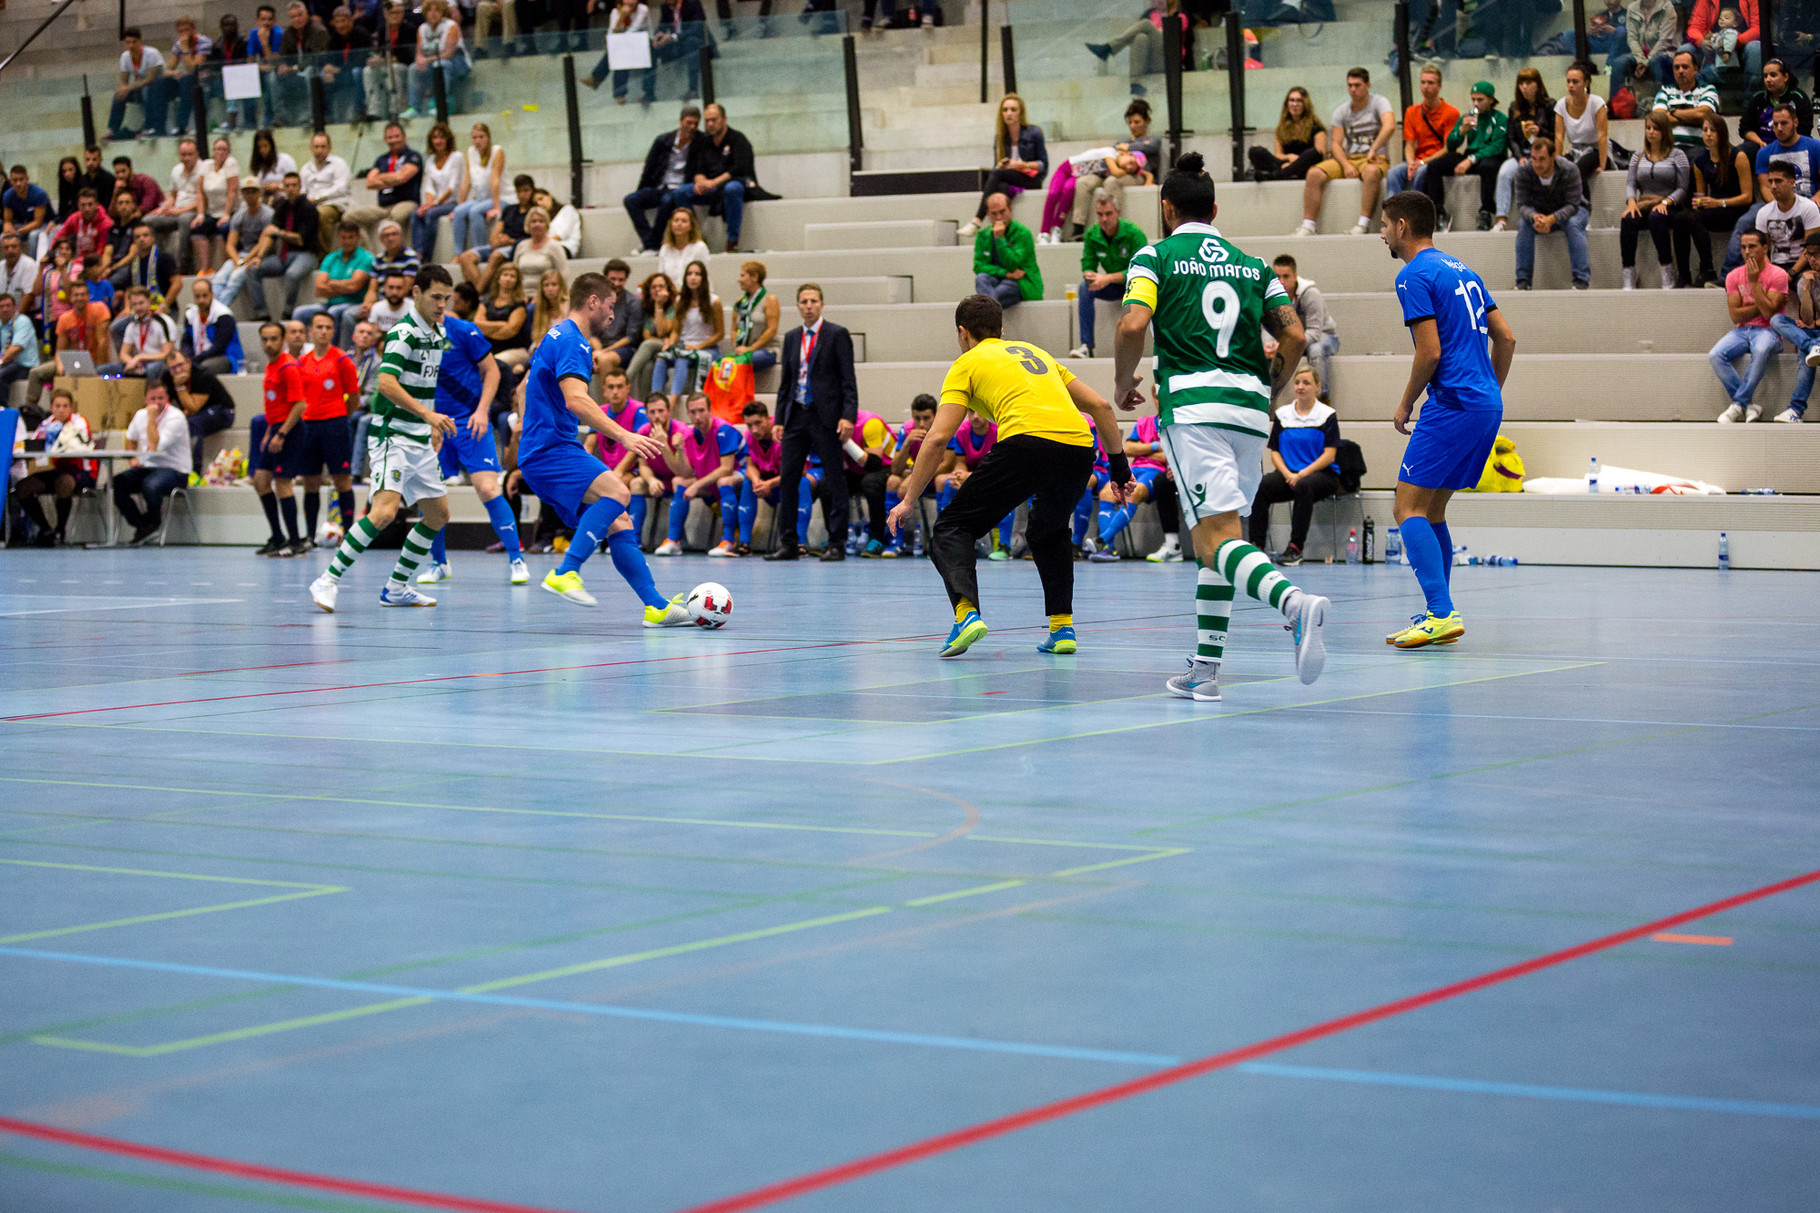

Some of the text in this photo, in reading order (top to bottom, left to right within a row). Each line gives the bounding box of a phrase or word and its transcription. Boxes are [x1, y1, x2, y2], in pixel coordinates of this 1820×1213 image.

[1173, 257, 1207, 276] JOÃO
[1201, 280, 1240, 358] 9
[1454, 279, 1488, 334] 12
[1005, 346, 1048, 375] 3
